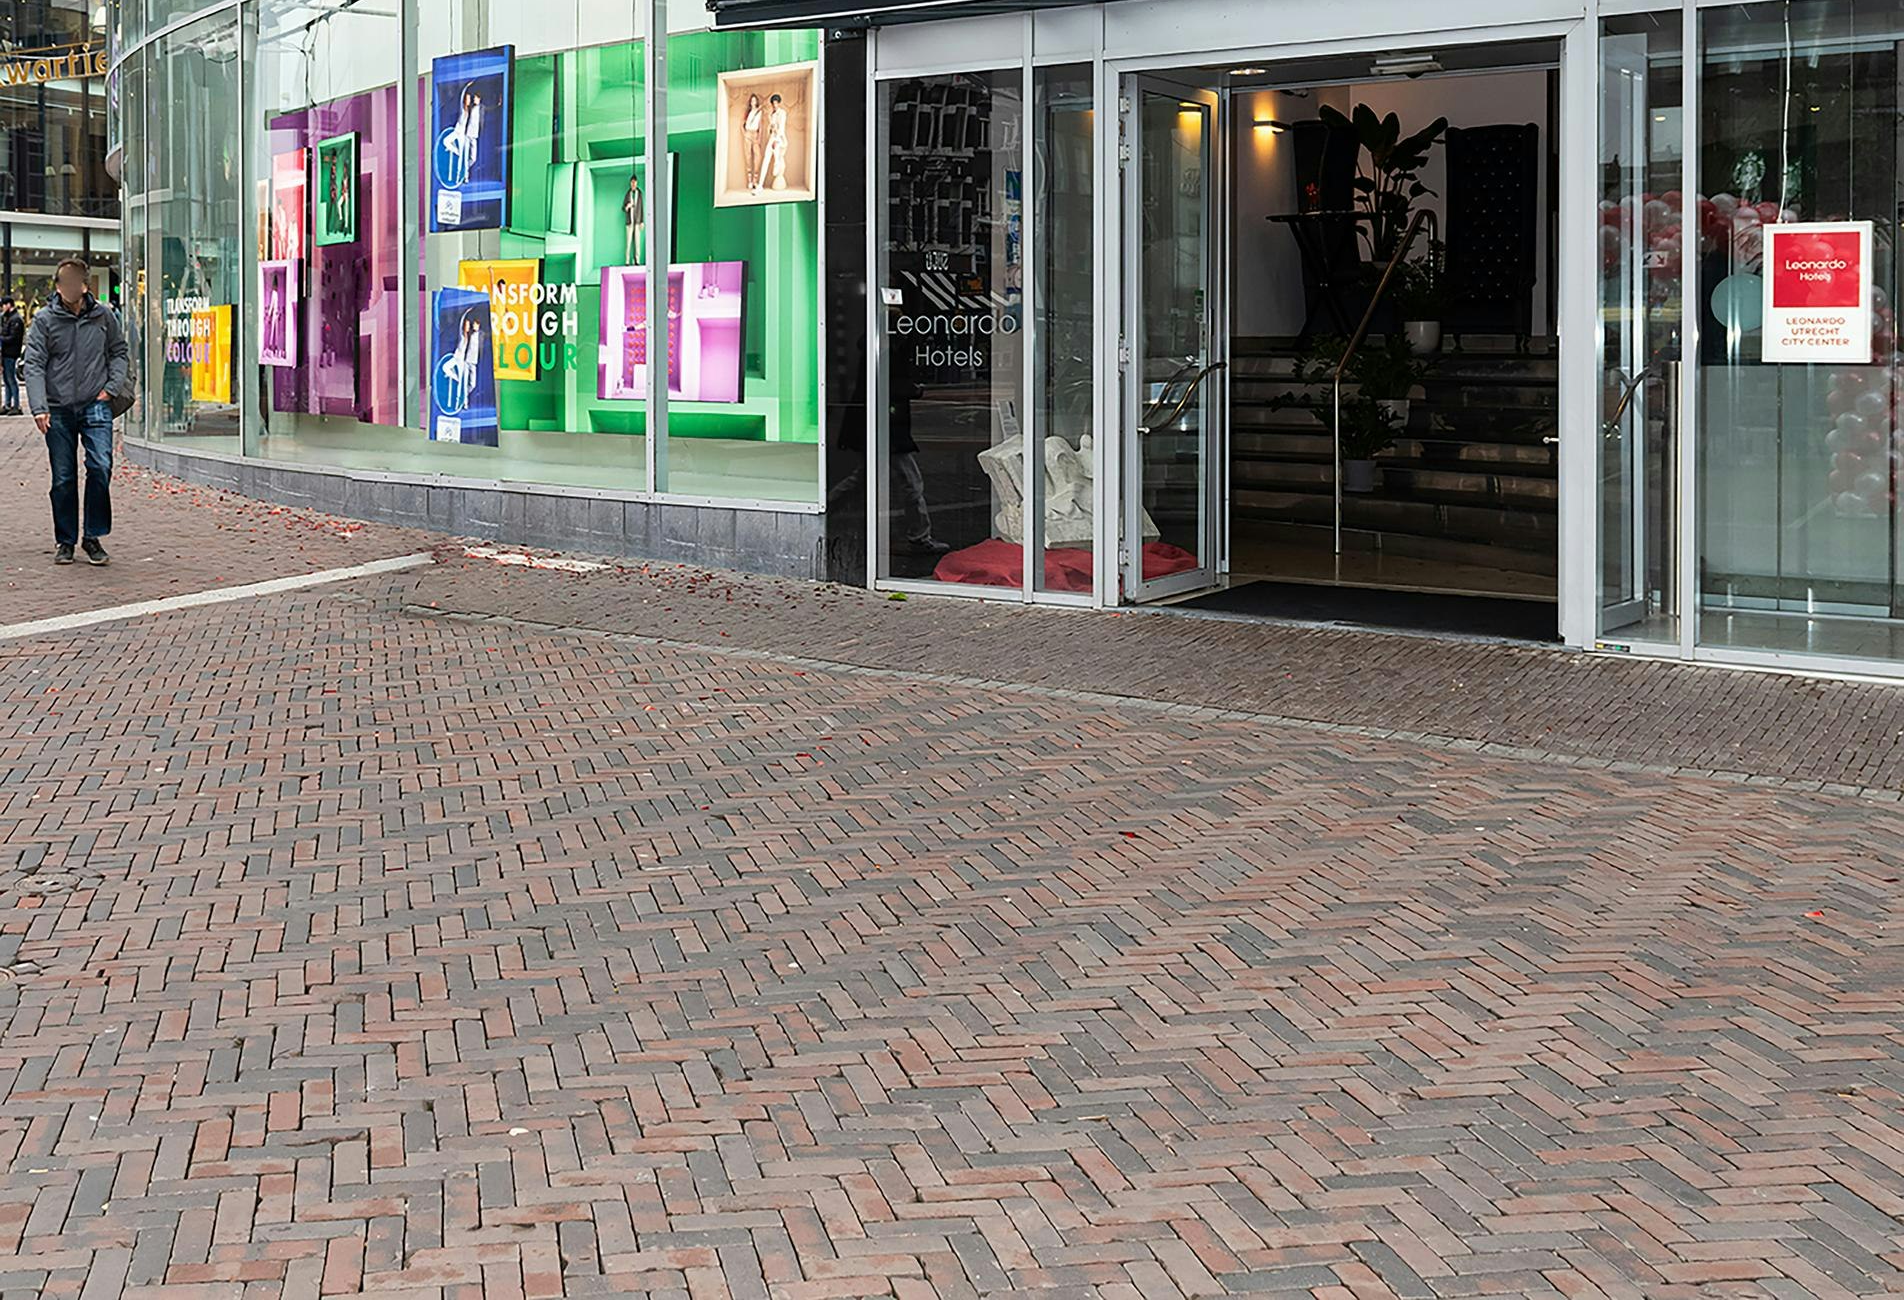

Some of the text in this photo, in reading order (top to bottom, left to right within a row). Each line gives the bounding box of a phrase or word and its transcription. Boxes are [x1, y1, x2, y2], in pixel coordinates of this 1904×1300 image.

[0, 42, 107, 88] wartie
[1785, 259, 1846, 270] Leonardo
[1799, 272, 1832, 282] Hotels
[490, 311, 578, 337] ROUGH
[885, 310, 1017, 335] Leonardo
[1786, 317, 1846, 325] LEONARDO
[1791, 327, 1840, 336] UTRECHT
[1781, 338, 1850, 346] CITY CENTER
[499, 342, 577, 371] LOUR
[915, 345, 984, 367] Hotels
